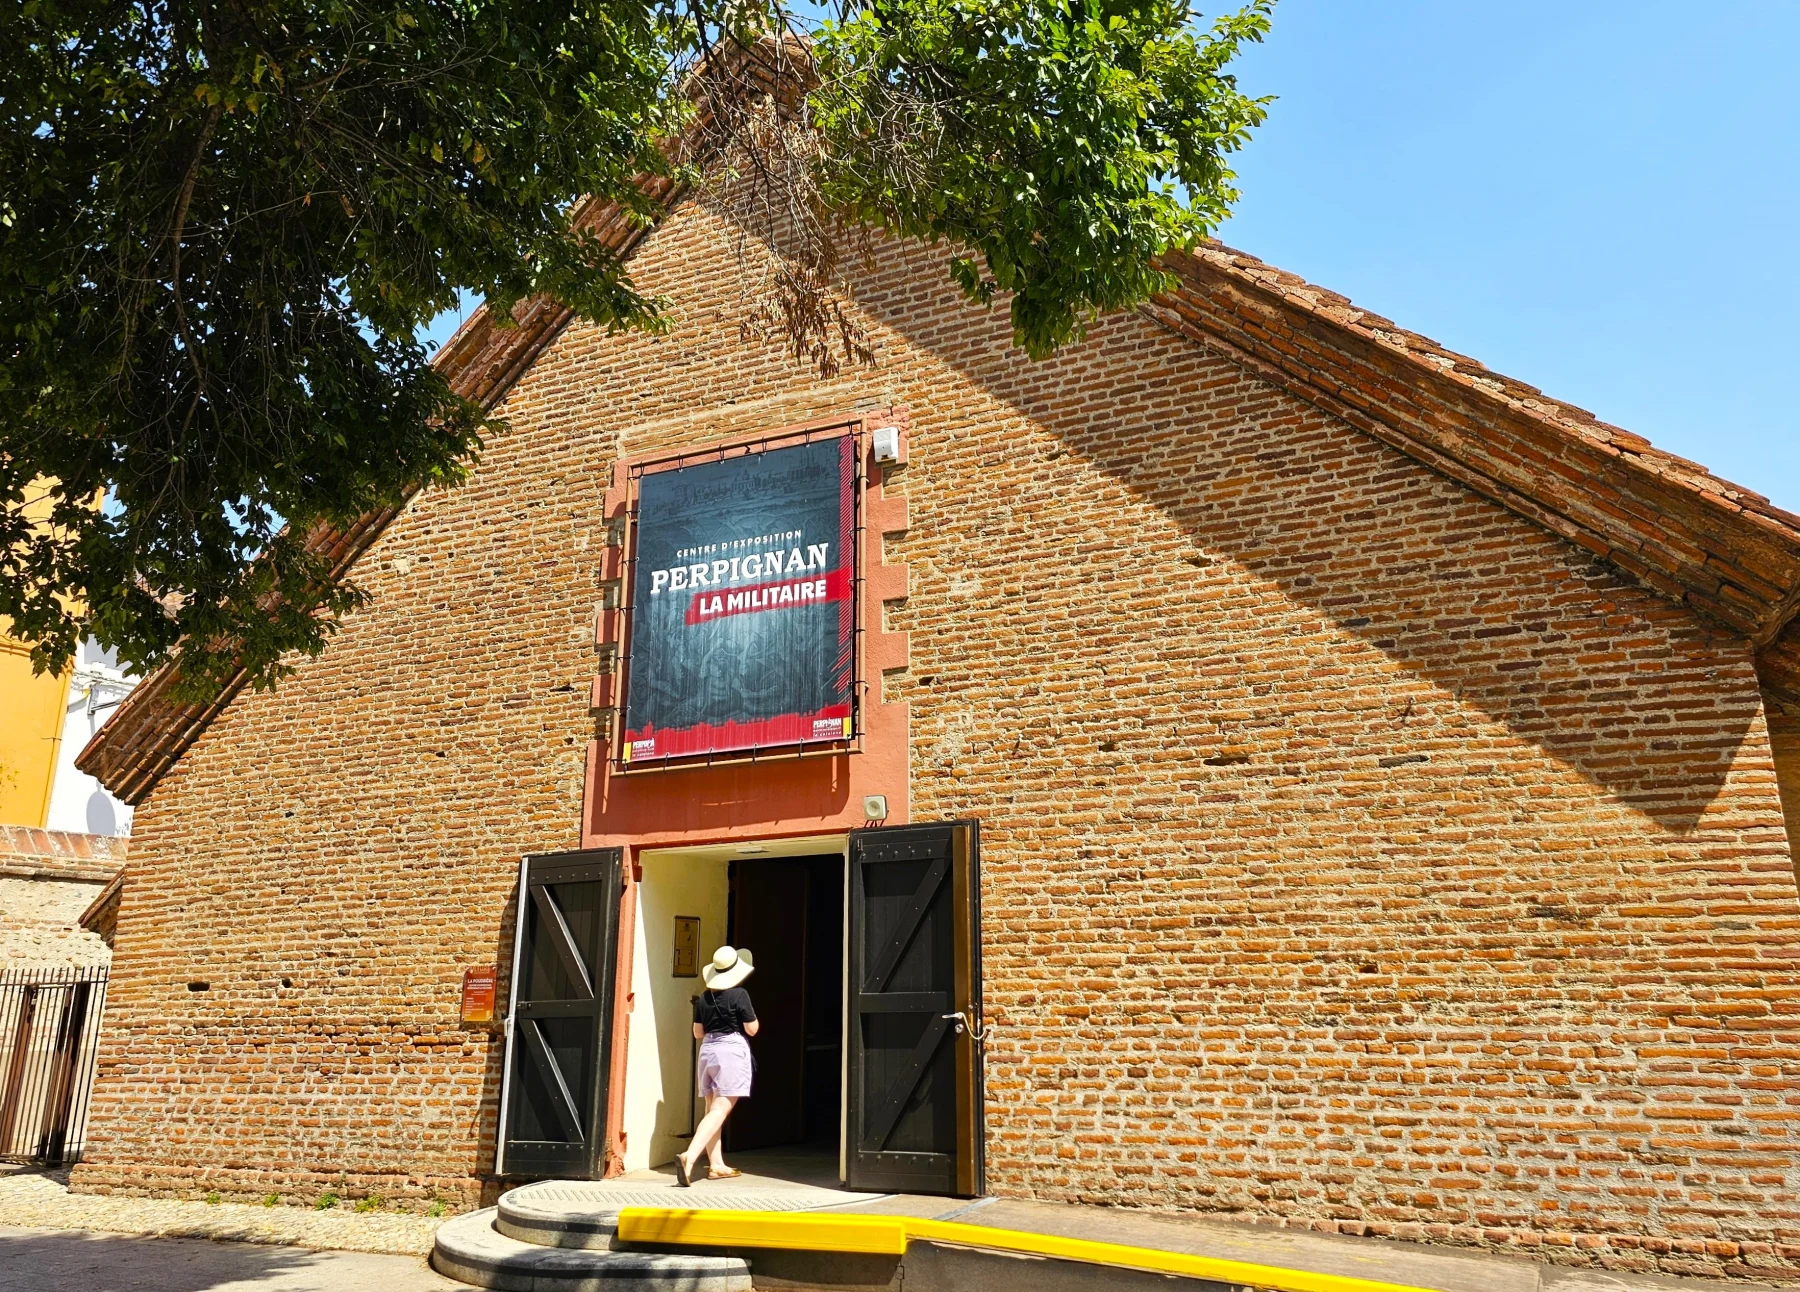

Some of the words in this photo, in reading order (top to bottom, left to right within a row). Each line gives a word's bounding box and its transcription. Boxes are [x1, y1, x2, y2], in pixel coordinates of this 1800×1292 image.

[677, 543, 716, 558] CENTRE
[722, 530, 802, 549] D'EXPOSITION
[650, 543, 829, 594] PERPIGNAN
[700, 597, 724, 615] LA
[728, 580, 827, 611] MILITAIRE
[813, 717, 842, 729] PERPIGNAN
